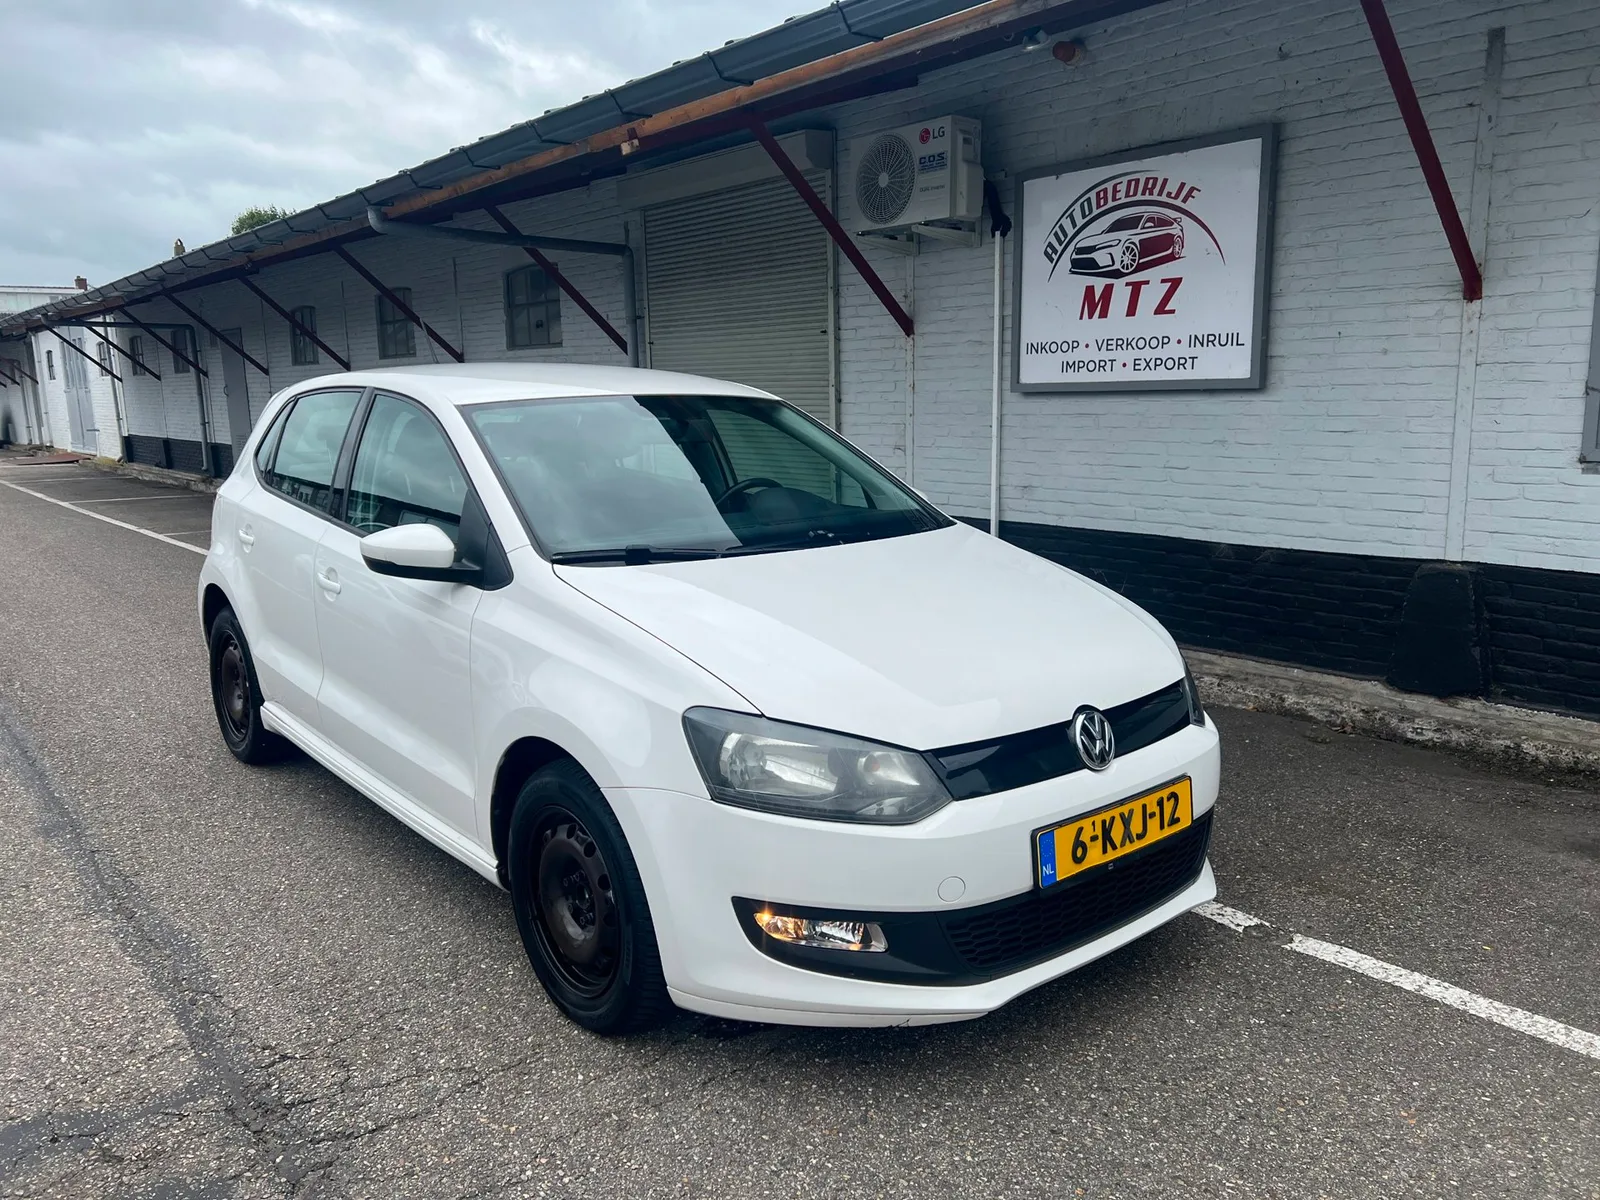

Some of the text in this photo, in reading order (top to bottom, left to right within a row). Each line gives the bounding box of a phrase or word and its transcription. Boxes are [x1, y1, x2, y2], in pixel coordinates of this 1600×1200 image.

[932, 126, 945, 139] LG
[1043, 176, 1201, 264] AUTOBEDRIJF
[1079, 277, 1183, 320] MTZ
[1025, 332, 1245, 355] INKOOP VERKOOP INRUIL
[1061, 356, 1198, 373] IMPORT EXPORT
[1071, 791, 1181, 864] 6-KXJ-12
[1042, 863, 1054, 877] NL
